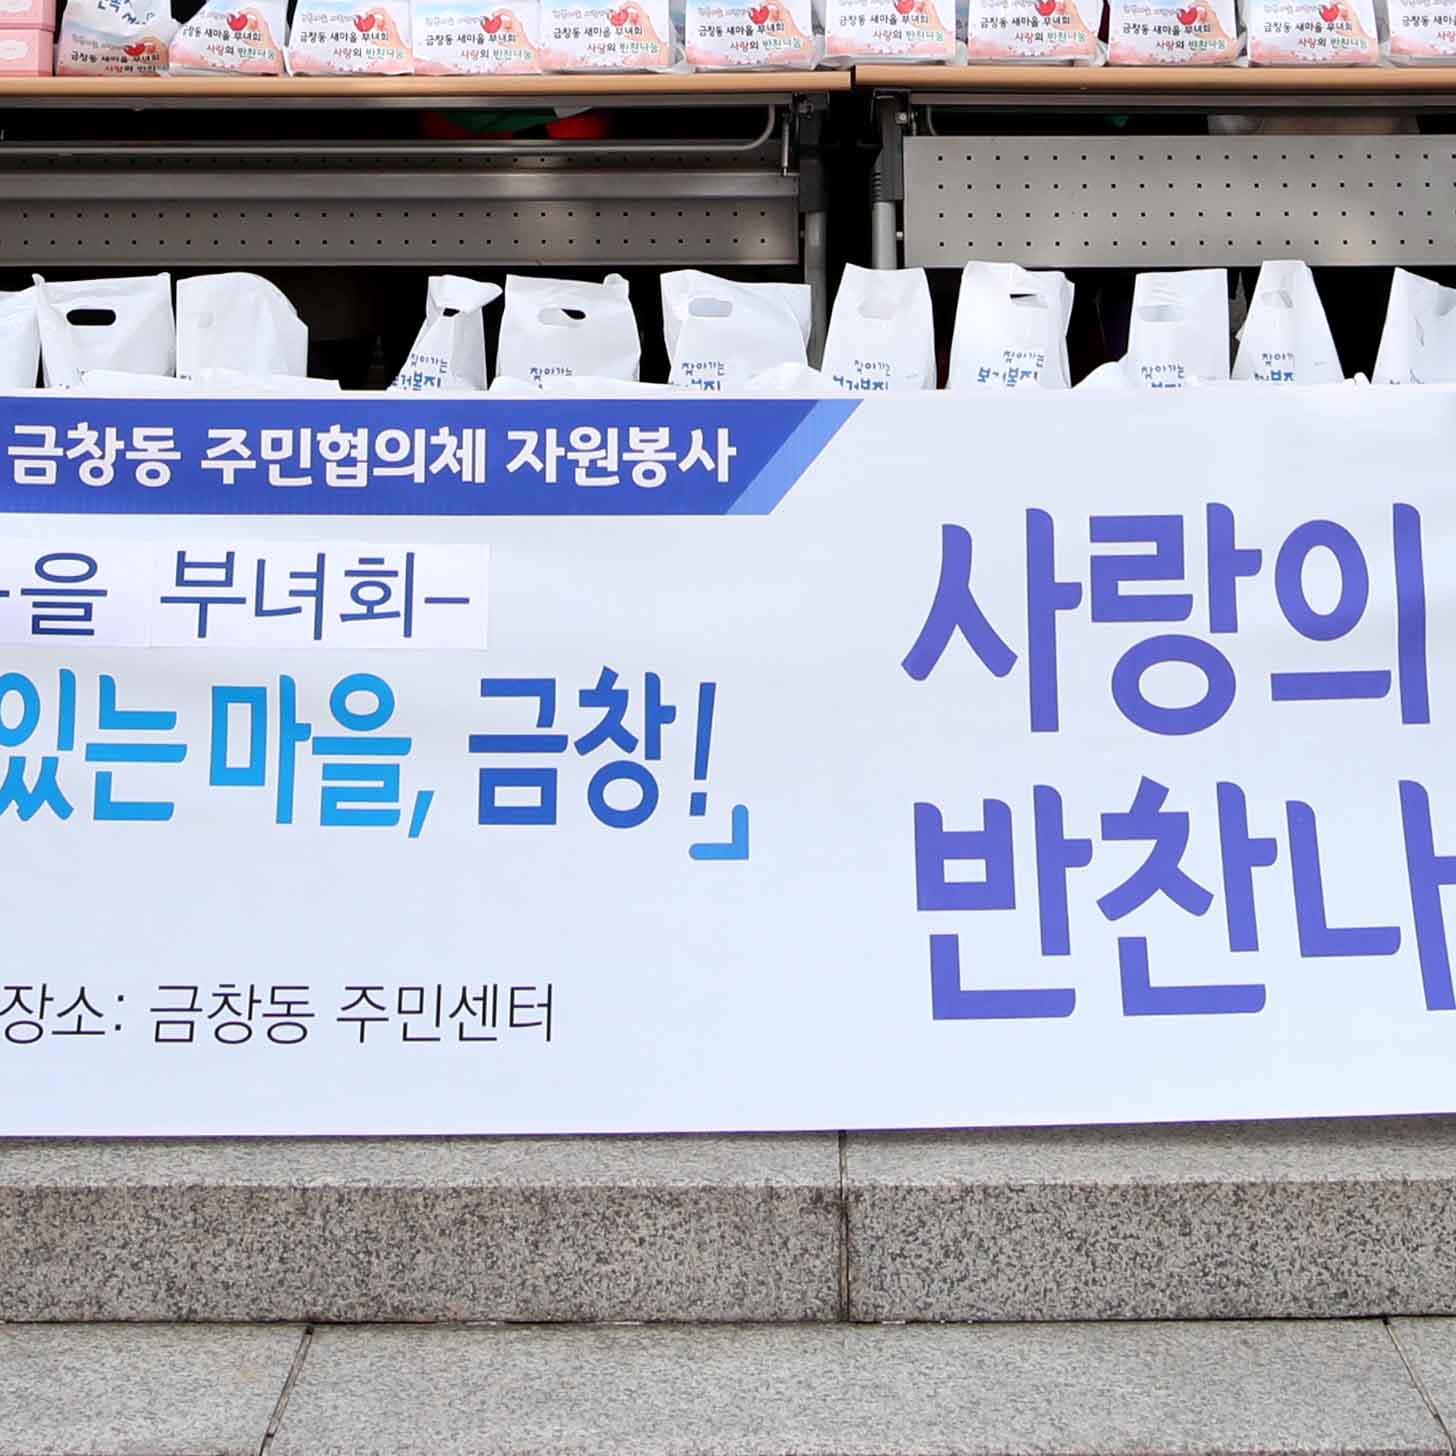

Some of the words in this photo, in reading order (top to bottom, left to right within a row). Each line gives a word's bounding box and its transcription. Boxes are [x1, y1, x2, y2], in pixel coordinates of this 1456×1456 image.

[682, 361, 725, 376] 찾아가는
[7, 422, 181, 487] 금창동
[200, 424, 486, 488] 주민협의체
[505, 426, 737, 489] 자원봉사
[900, 501, 1432, 737] 사랑의
[149, 983, 316, 1045] 금창동
[335, 983, 554, 1045] 주민센터
